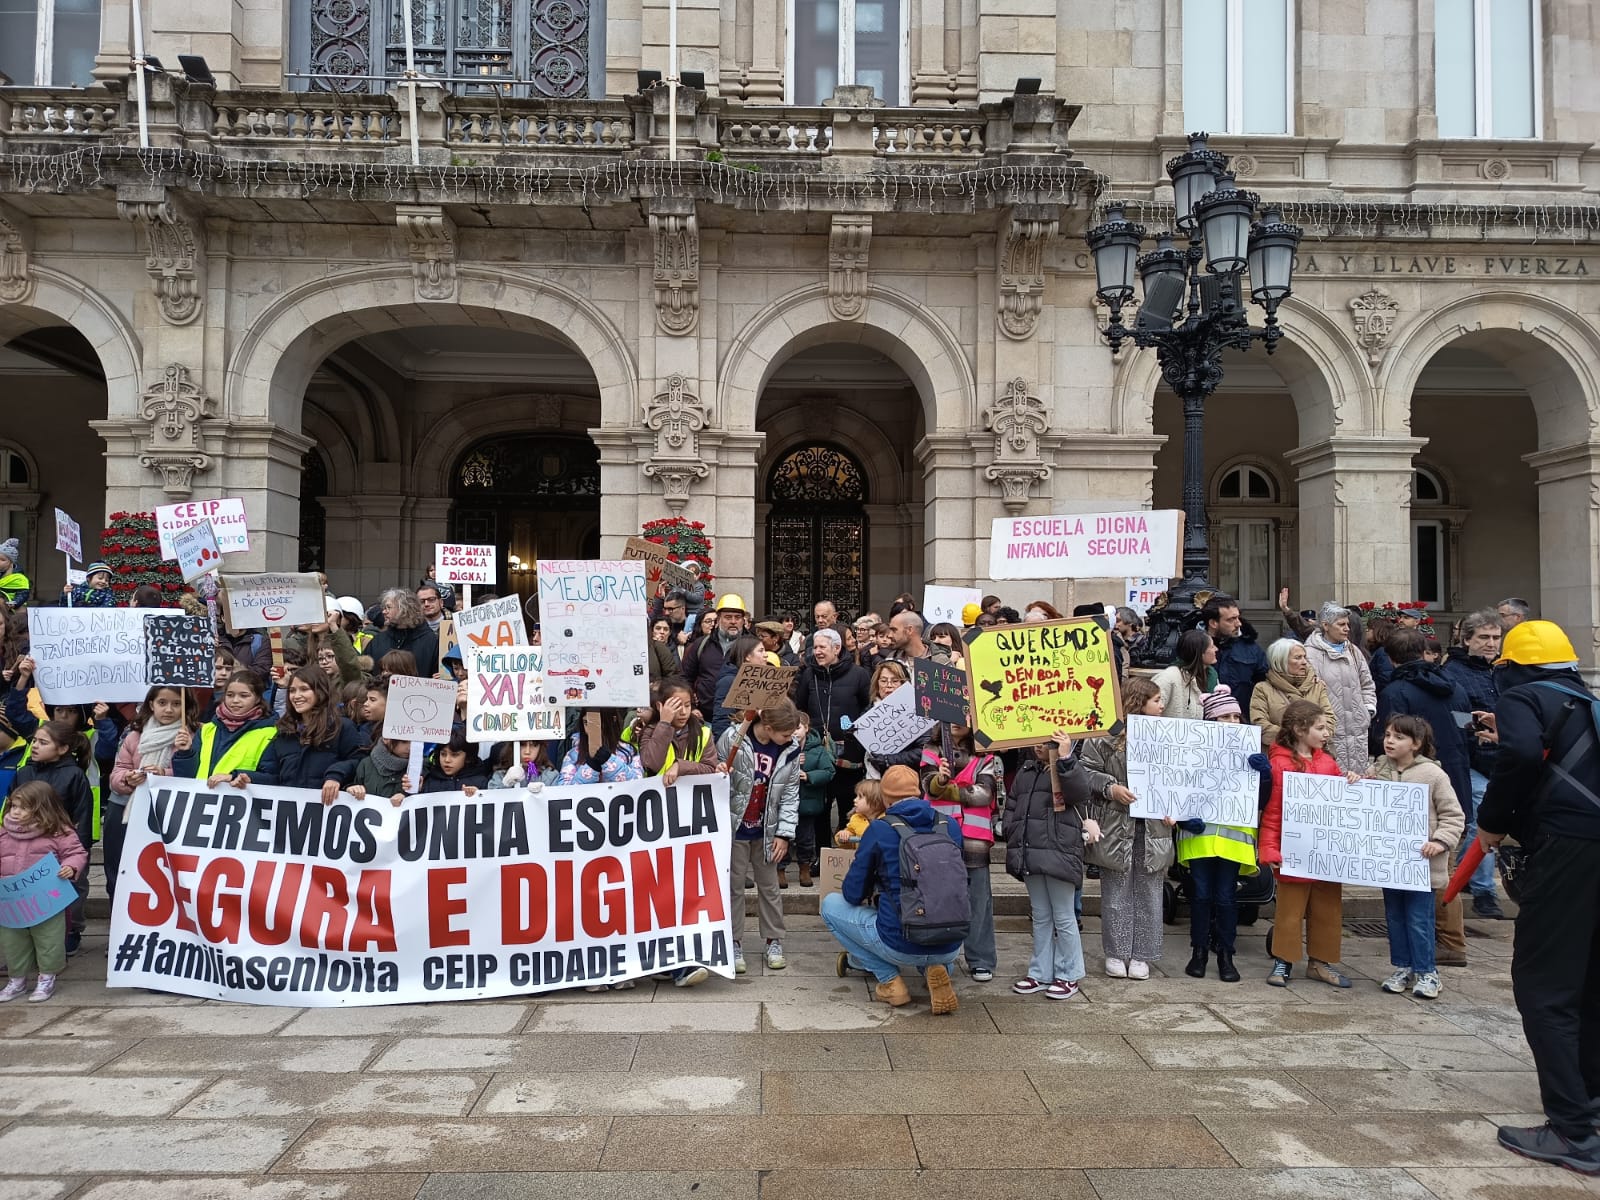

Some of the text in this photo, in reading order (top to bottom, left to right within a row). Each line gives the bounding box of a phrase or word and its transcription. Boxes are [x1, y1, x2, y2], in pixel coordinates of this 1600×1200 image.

[1340, 257, 1353, 271] Y
[1373, 256, 1456, 273] LLAVE
[174, 501, 219, 518] CEIP
[212, 514, 246, 525] VELLA
[1013, 516, 1148, 537] ESCUELA DIGNA
[442, 546, 462, 555] POR
[625, 547, 664, 565] FUTURO
[1007, 537, 1151, 559] INFANCIA SEGURA
[442, 557, 487, 567] ESCOLA
[541, 561, 643, 573] NECESITAMOS
[540, 576, 647, 602] MEJORAR
[458, 598, 518, 626] REFORMAS
[1000, 654, 1050, 667] UNHA
[39, 661, 145, 689] CIUDADAN
[739, 679, 789, 690] FRANCESA
[1005, 667, 1074, 684] BEN BOA E
[478, 673, 525, 710] XA!
[472, 711, 561, 731] CIDADE VELLA
[879, 720, 908, 743] COLE
[1148, 766, 1241, 793] PROMESAS
[397, 801, 529, 861] UNHA
[548, 784, 718, 852] ESCOLA
[1313, 828, 1425, 862] PROMESAS
[128, 841, 725, 952] SEGURA E DIGNA
[114, 930, 728, 993] #familiasenloita CEIP CIDADE VELLA
